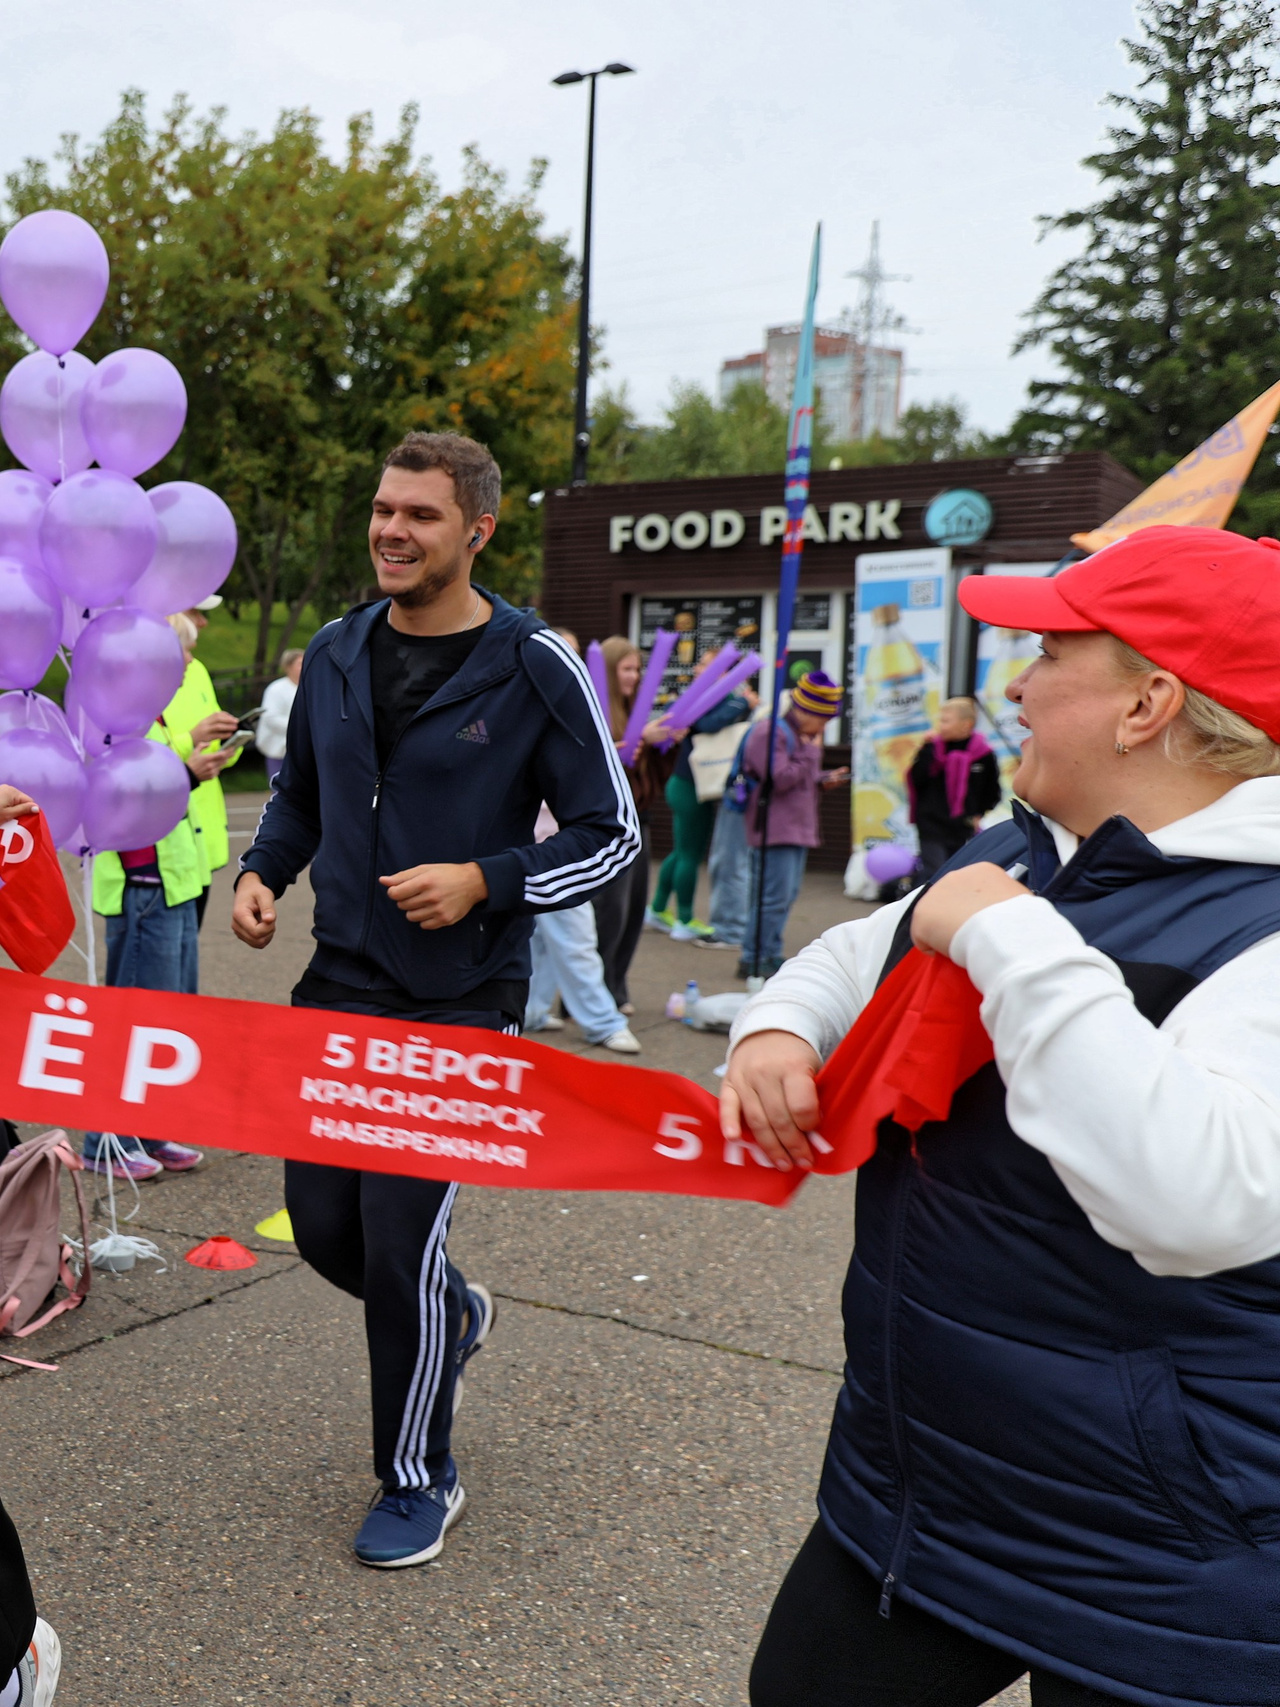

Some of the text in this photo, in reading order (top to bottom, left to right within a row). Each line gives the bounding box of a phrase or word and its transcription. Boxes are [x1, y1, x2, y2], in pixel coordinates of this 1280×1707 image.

[609, 499, 902, 554] FOOD PARK
[321, 1032, 535, 1094] 5 ВЁРСТ
[299, 1075, 546, 1137] КРАСНОЯРСК
[309, 1114, 528, 1169] НАБЕРЕЖНАЯ
[652, 1111, 704, 1161] 5
